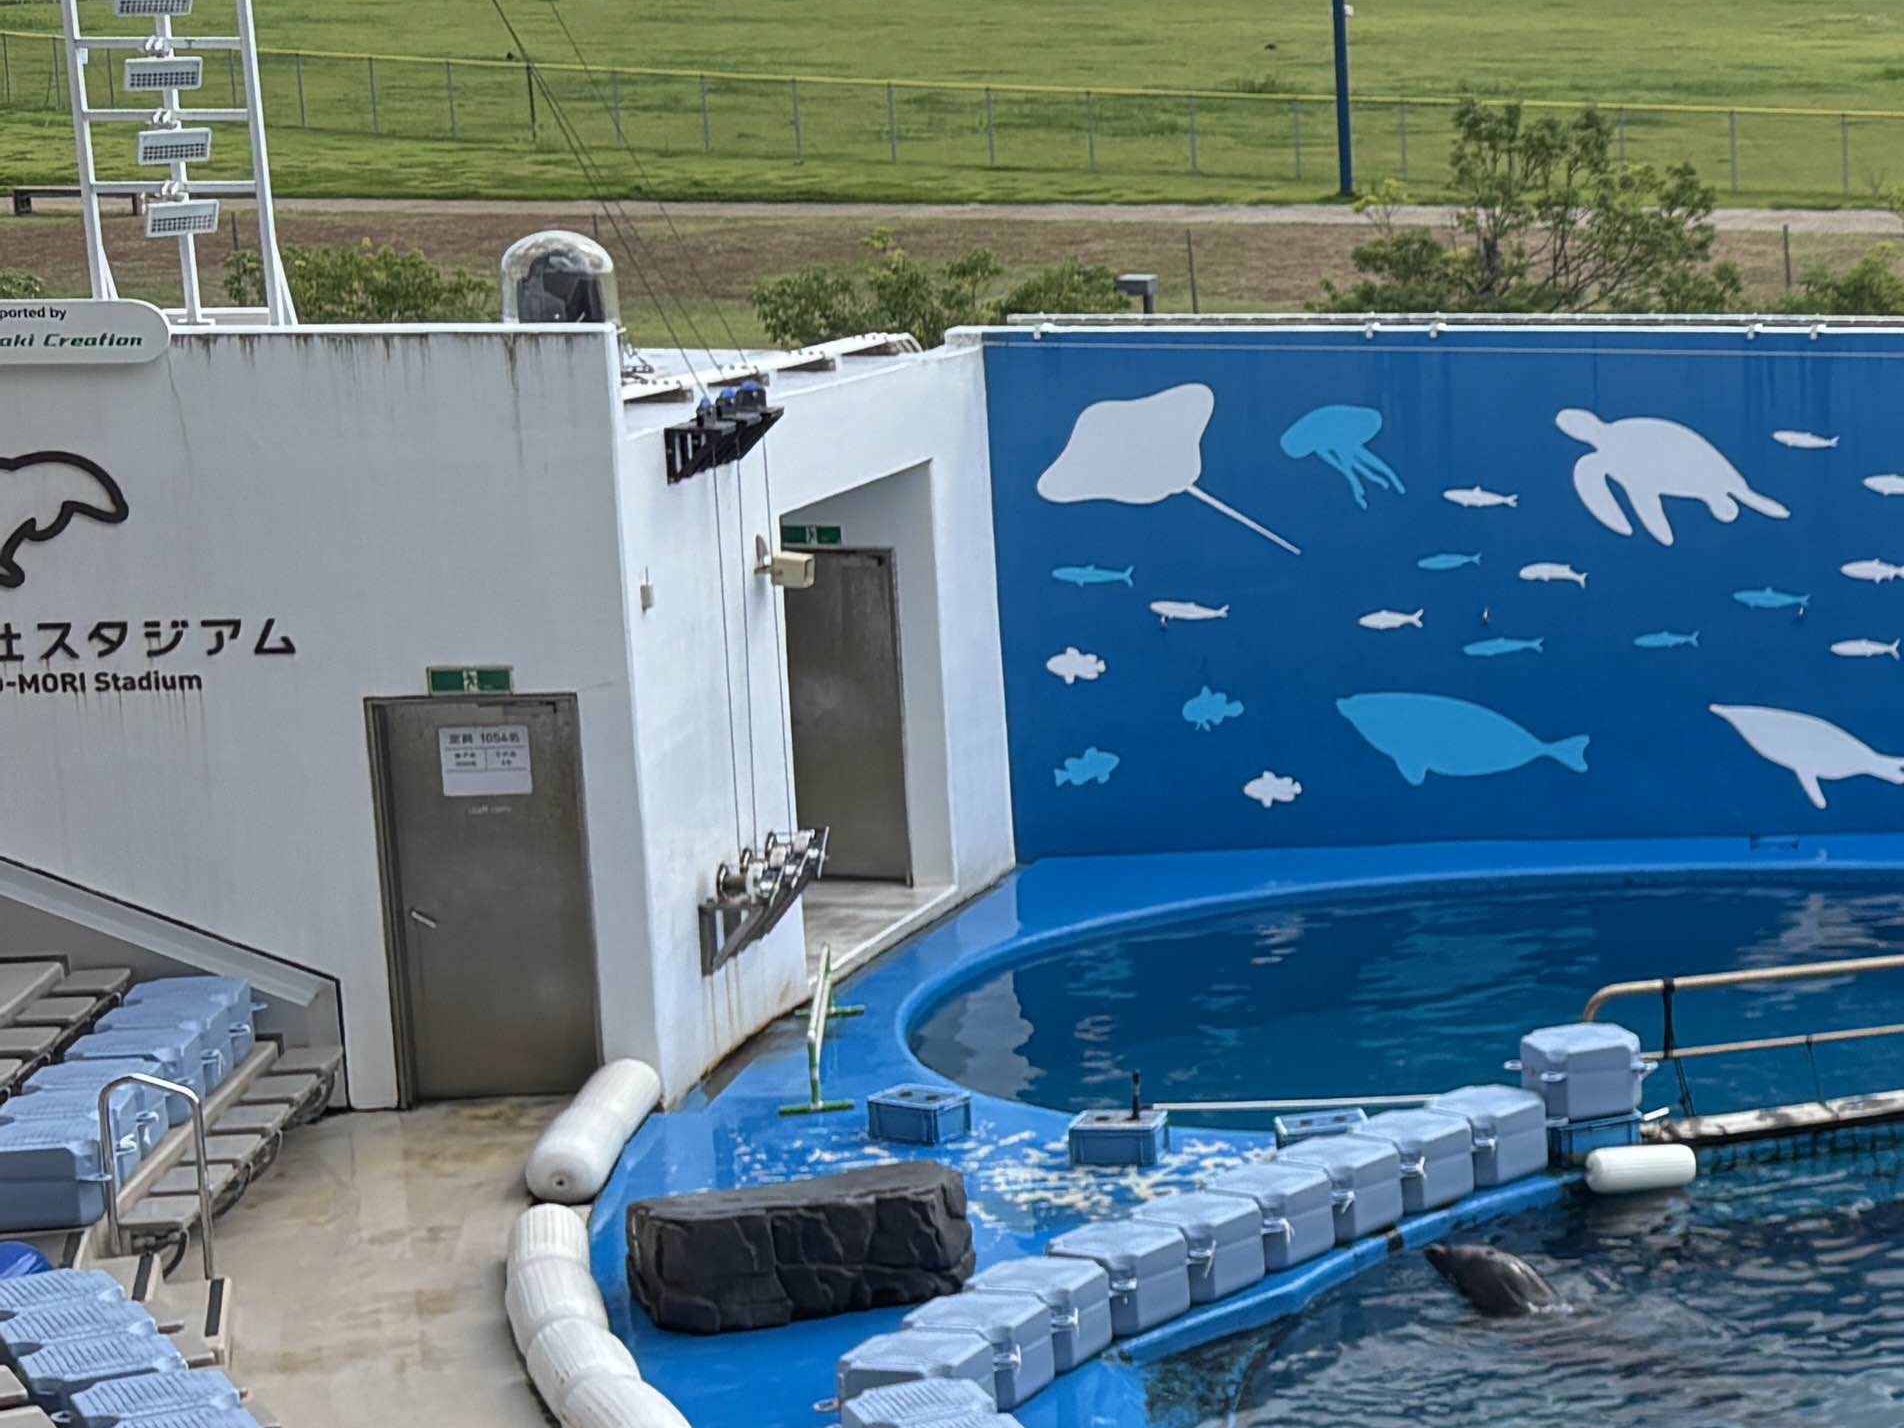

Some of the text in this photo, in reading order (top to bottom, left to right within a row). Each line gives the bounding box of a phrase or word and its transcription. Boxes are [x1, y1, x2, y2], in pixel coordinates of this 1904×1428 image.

[50, 306, 67, 321] by
[43, 332, 144, 347] Creation
[0, 671, 202, 694] -MORI Stadium
